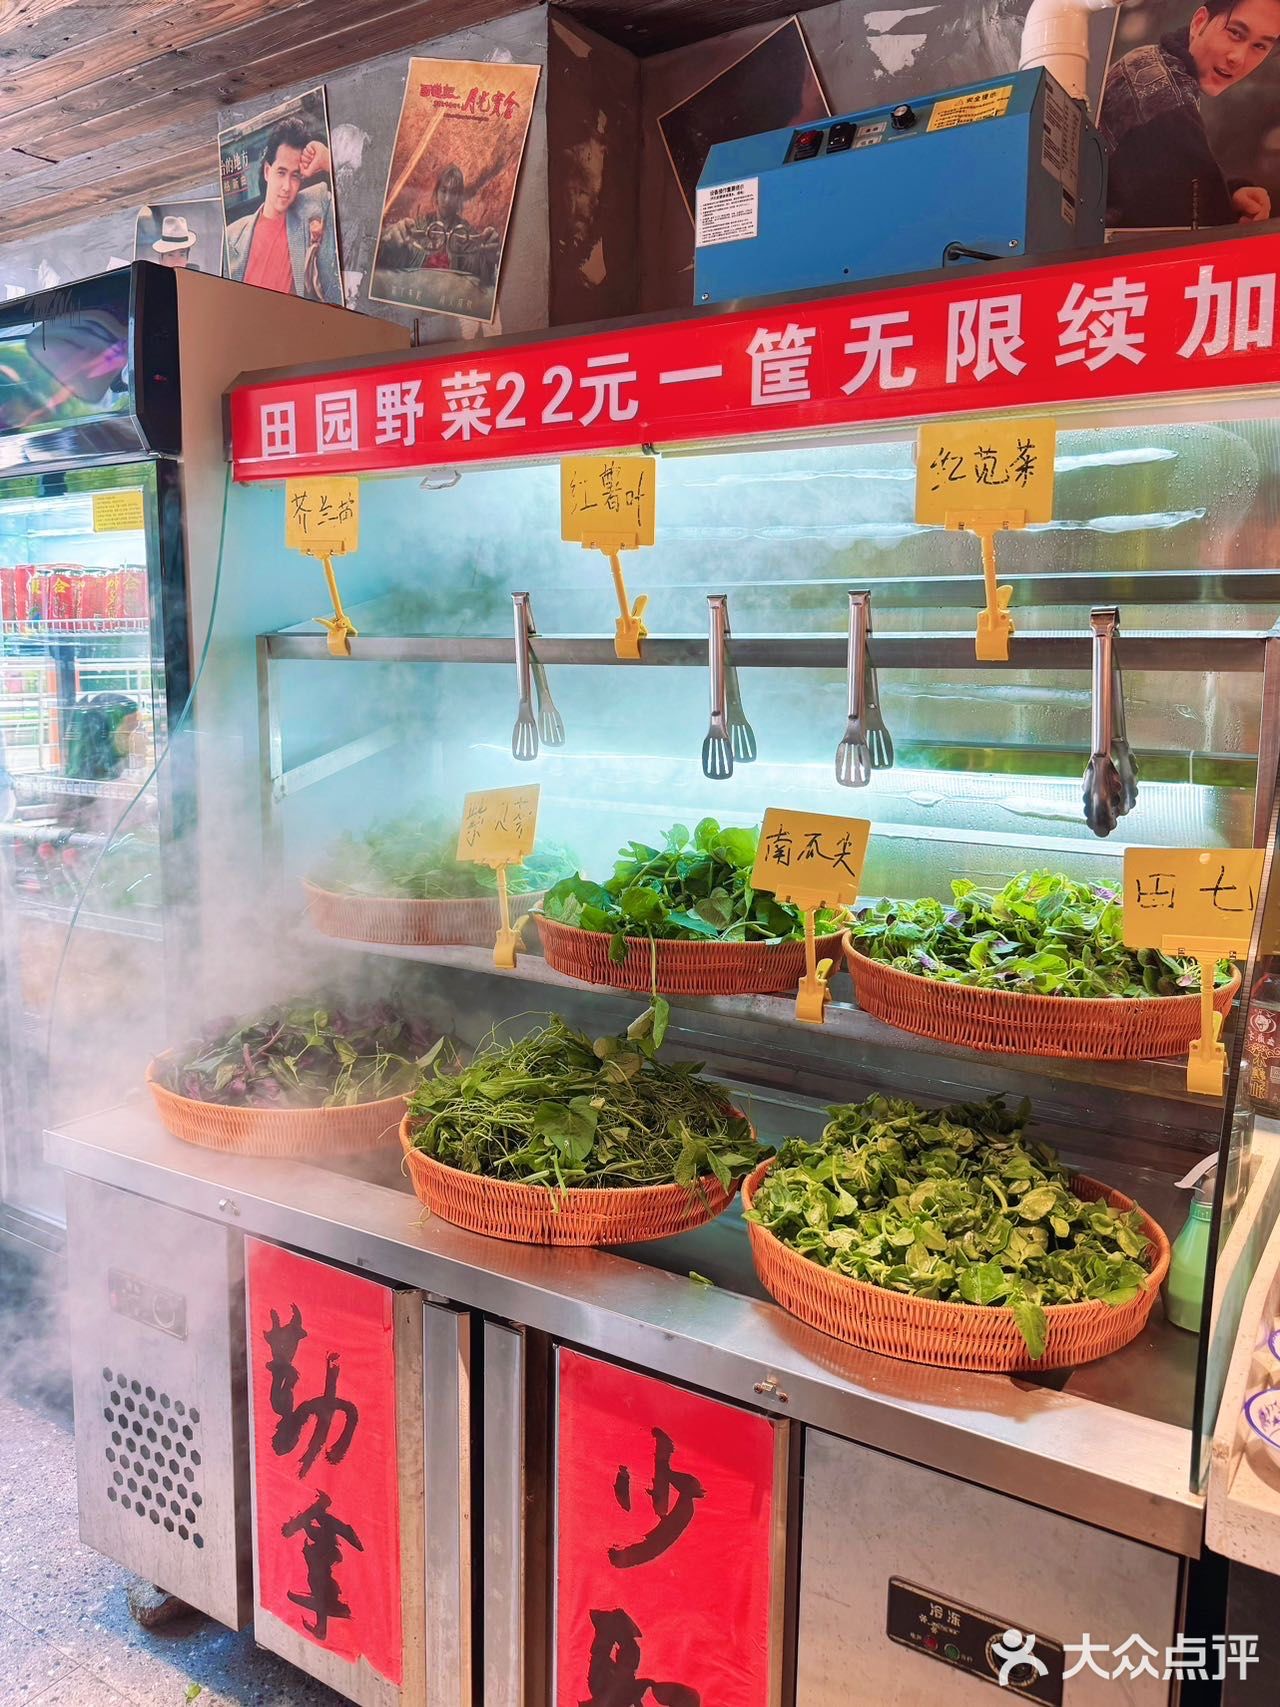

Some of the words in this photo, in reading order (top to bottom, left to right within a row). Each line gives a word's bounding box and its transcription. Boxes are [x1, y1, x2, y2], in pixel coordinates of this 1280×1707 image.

[260, 265, 1277, 457] 田园野菜22元一筐无限续加
[570, 460, 645, 528] 红薯叶
[765, 823, 855, 877] 南瓜尖
